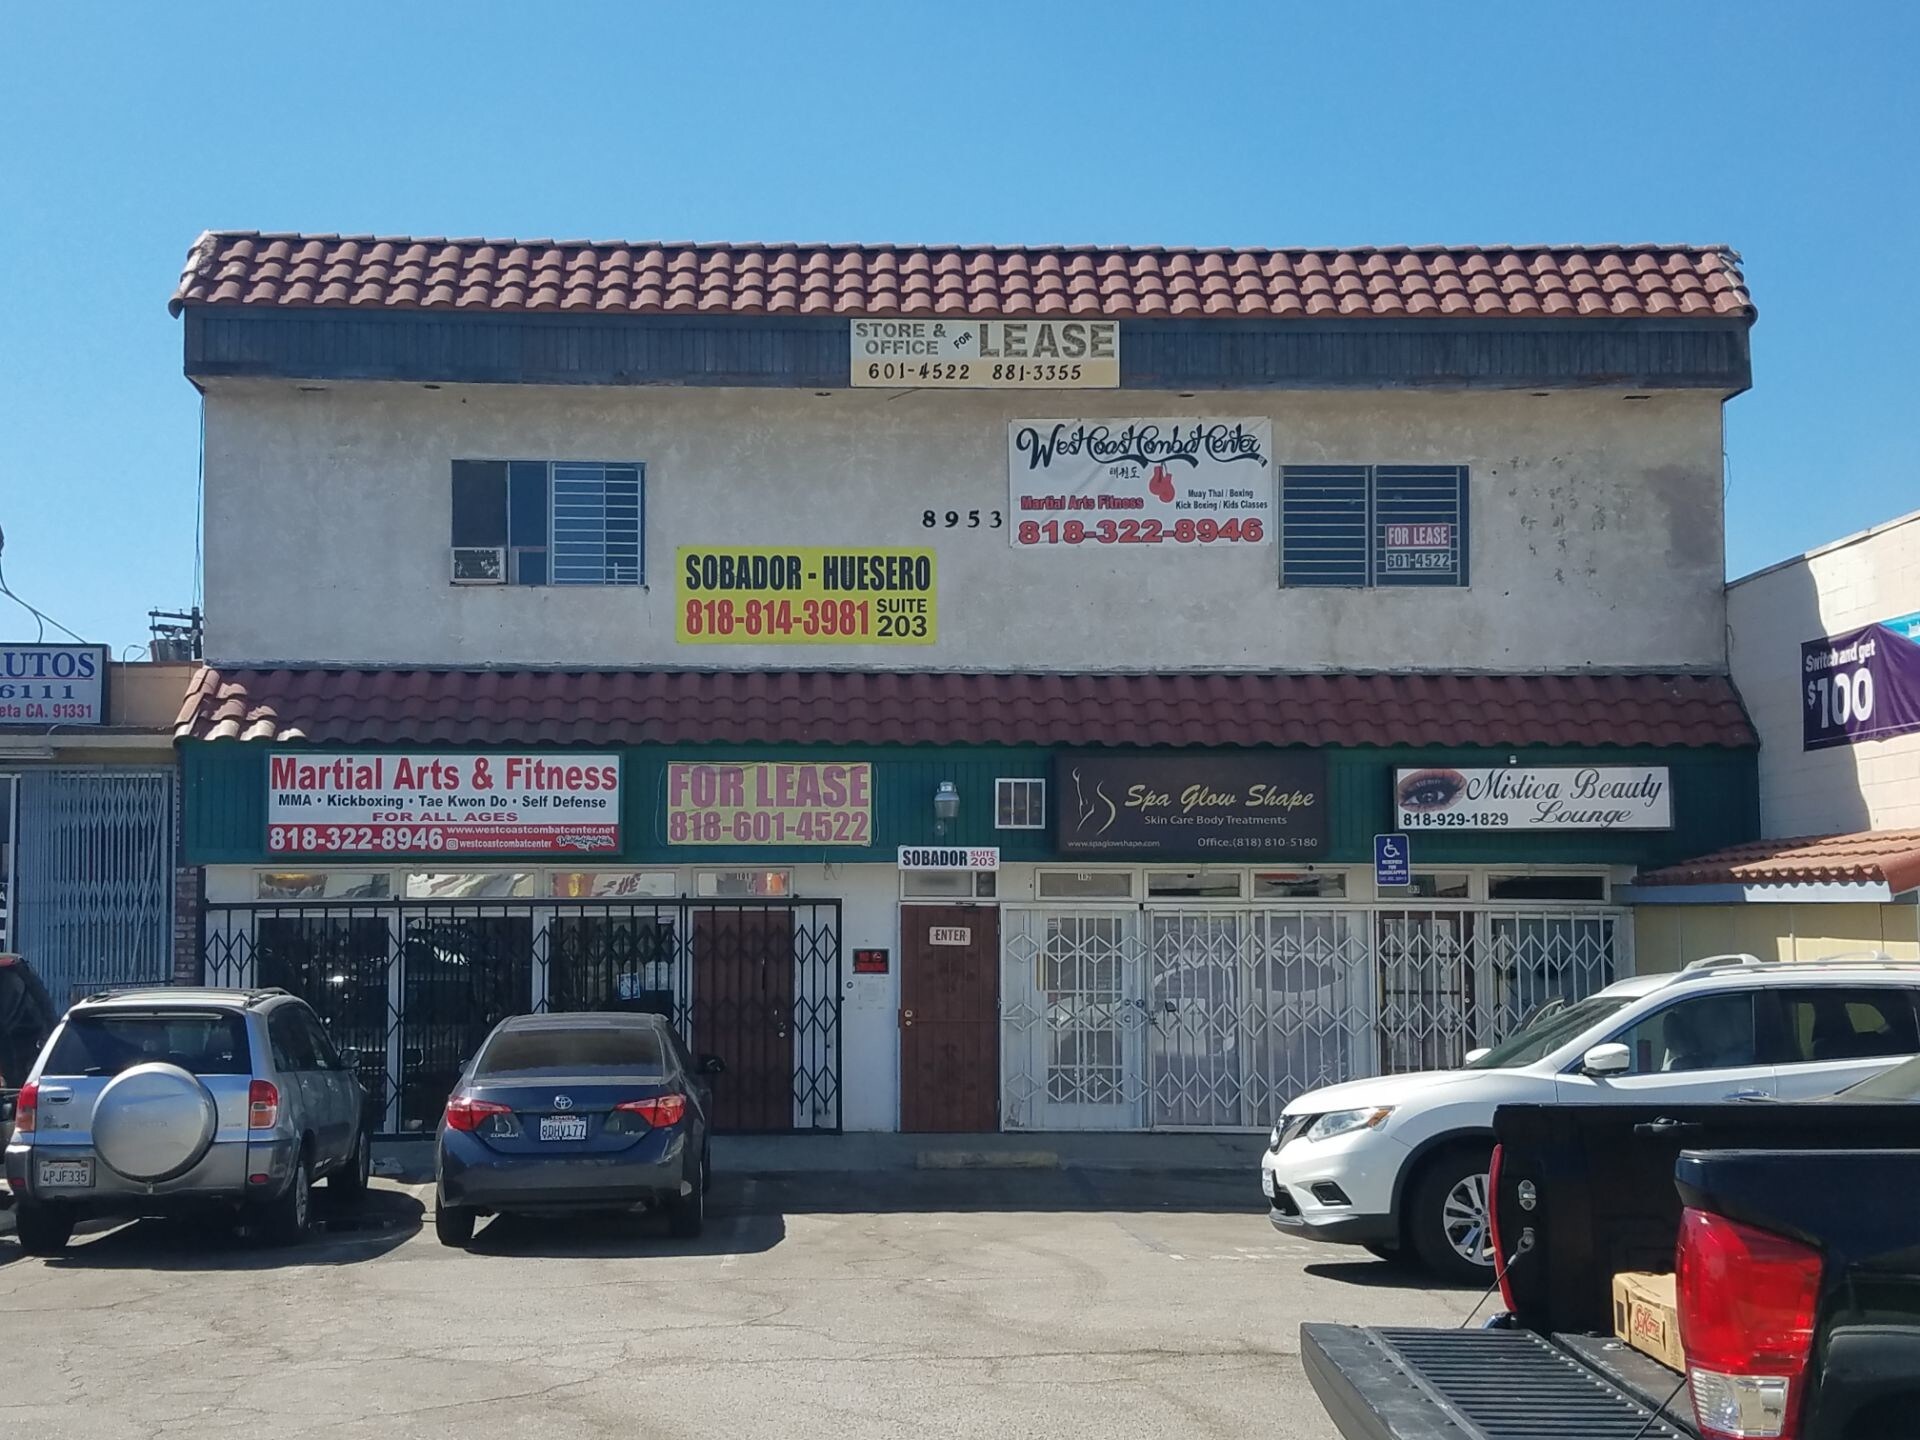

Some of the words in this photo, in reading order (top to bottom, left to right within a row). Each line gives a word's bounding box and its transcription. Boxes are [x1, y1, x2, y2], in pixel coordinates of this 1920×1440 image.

[855, 323, 925, 338] STORE
[933, 323, 947, 338] &
[865, 340, 939, 355] OFFICE
[953, 331, 973, 350] FOR
[979, 323, 1115, 358] LEASE
[868, 362, 971, 380] 601-4522
[992, 363, 1082, 382] 881-3355
[1016, 423, 1084, 470] West
[1085, 425, 1148, 469] Coast
[1136, 424, 1203, 469] Combat
[1205, 424, 1267, 467] Center
[1020, 495, 1066, 510] Martial
[1068, 495, 1096, 510] Arts
[1097, 495, 1144, 510] Fitness
[1188, 489, 1207, 500] Muay
[1208, 489, 1224, 498] Thai
[1229, 488, 1254, 499] Boxing
[1175, 500, 1191, 509] Kick
[1193, 501, 1218, 511] Boxing
[1223, 501, 1239, 509] Kids
[1240, 500, 1268, 509] Classes
[922, 510, 1002, 528] 8953
[1018, 518, 1265, 544] 818-322-8946
[1388, 527, 1409, 545] FOR
[1413, 526, 1448, 545] LEASE
[1387, 554, 1450, 569] 601-4522
[686, 554, 802, 591] SOBADOR
[823, 555, 931, 591] HUESERO
[876, 598, 928, 613] SUITE
[686, 599, 869, 635] 818-814-3981
[877, 615, 928, 637] 203
[0, 652, 95, 678] UTOS
[1805, 648, 1839, 673] Switch
[1839, 641, 1858, 665] and
[1859, 639, 1876, 665] get
[1807, 667, 1874, 729] $100
[26, 703, 49, 718] CA.
[53, 703, 92, 718] 91331
[271, 757, 382, 790] Martial
[393, 757, 460, 790] Arts
[471, 757, 494, 790] &
[506, 757, 617, 790] Fitness
[670, 765, 745, 807] FOR
[756, 765, 869, 807] LEASE
[1466, 769, 1562, 800] Mistica
[1569, 768, 1663, 807] Beauty
[278, 794, 312, 806] MMA
[327, 794, 404, 809] Kickboxing
[419, 795, 443, 808] Tae
[448, 795, 487, 808] Kwon
[490, 795, 508, 808] Do
[522, 795, 548, 808] Self
[552, 796, 607, 809] Defense
[1124, 784, 1172, 811] Spa
[1181, 784, 1237, 812] Glow
[1245, 784, 1315, 808] Shape
[372, 812, 414, 822] FOR
[420, 812, 458, 822] ALL
[464, 812, 519, 822] AGES
[1144, 815, 1167, 825] Skin
[1170, 815, 1194, 825] Care
[1196, 815, 1225, 827] Body
[1226, 815, 1288, 825] Treatments
[1403, 813, 1509, 827] 818-929-1829
[1529, 800, 1634, 828] Lounge
[446, 826, 615, 834] www.westcoastcombatcenter.net
[670, 811, 869, 842] 818-601-4522
[269, 827, 444, 851] 818-322-8946
[459, 839, 553, 849] westcoastcombatcenter
[1067, 839, 1161, 849] www.spaglowshape.com
[1264, 838, 1318, 848] 810-5180
[903, 850, 968, 867] SOBADOR
[970, 857, 996, 867] 203
[934, 929, 967, 942] ENTER
